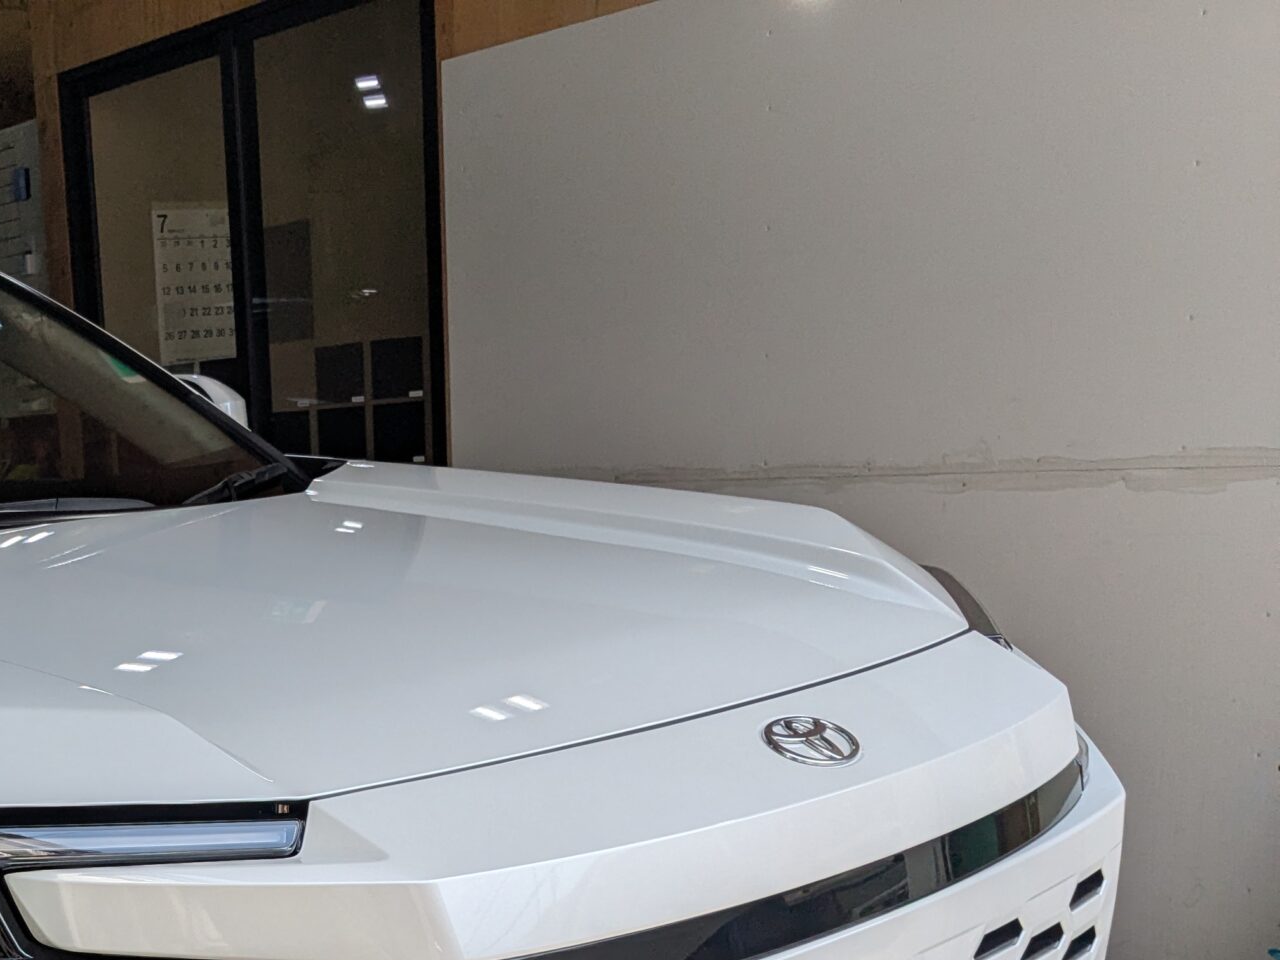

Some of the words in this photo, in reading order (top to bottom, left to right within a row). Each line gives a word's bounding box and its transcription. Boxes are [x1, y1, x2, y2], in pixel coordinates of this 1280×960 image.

[156, 214, 168, 233] 7
[212, 239, 218, 248] 2
[162, 263, 168, 272] 5
[175, 263, 181, 272] 6
[188, 262, 194, 271] 7
[162, 287, 171, 296] 12
[176, 286, 184, 295] 13
[188, 285, 196, 294] 14
[201, 284, 210, 294] 15
[214, 284, 223, 293] 16
[190, 307, 198, 317] 21
[202, 306, 211, 316] 22
[214, 306, 224, 316] 23
[164, 332, 175, 341] 26
[177, 330, 187, 340] 27
[191, 330, 200, 339] 28
[203, 329, 213, 338] 29
[216, 328, 225, 338] 30
